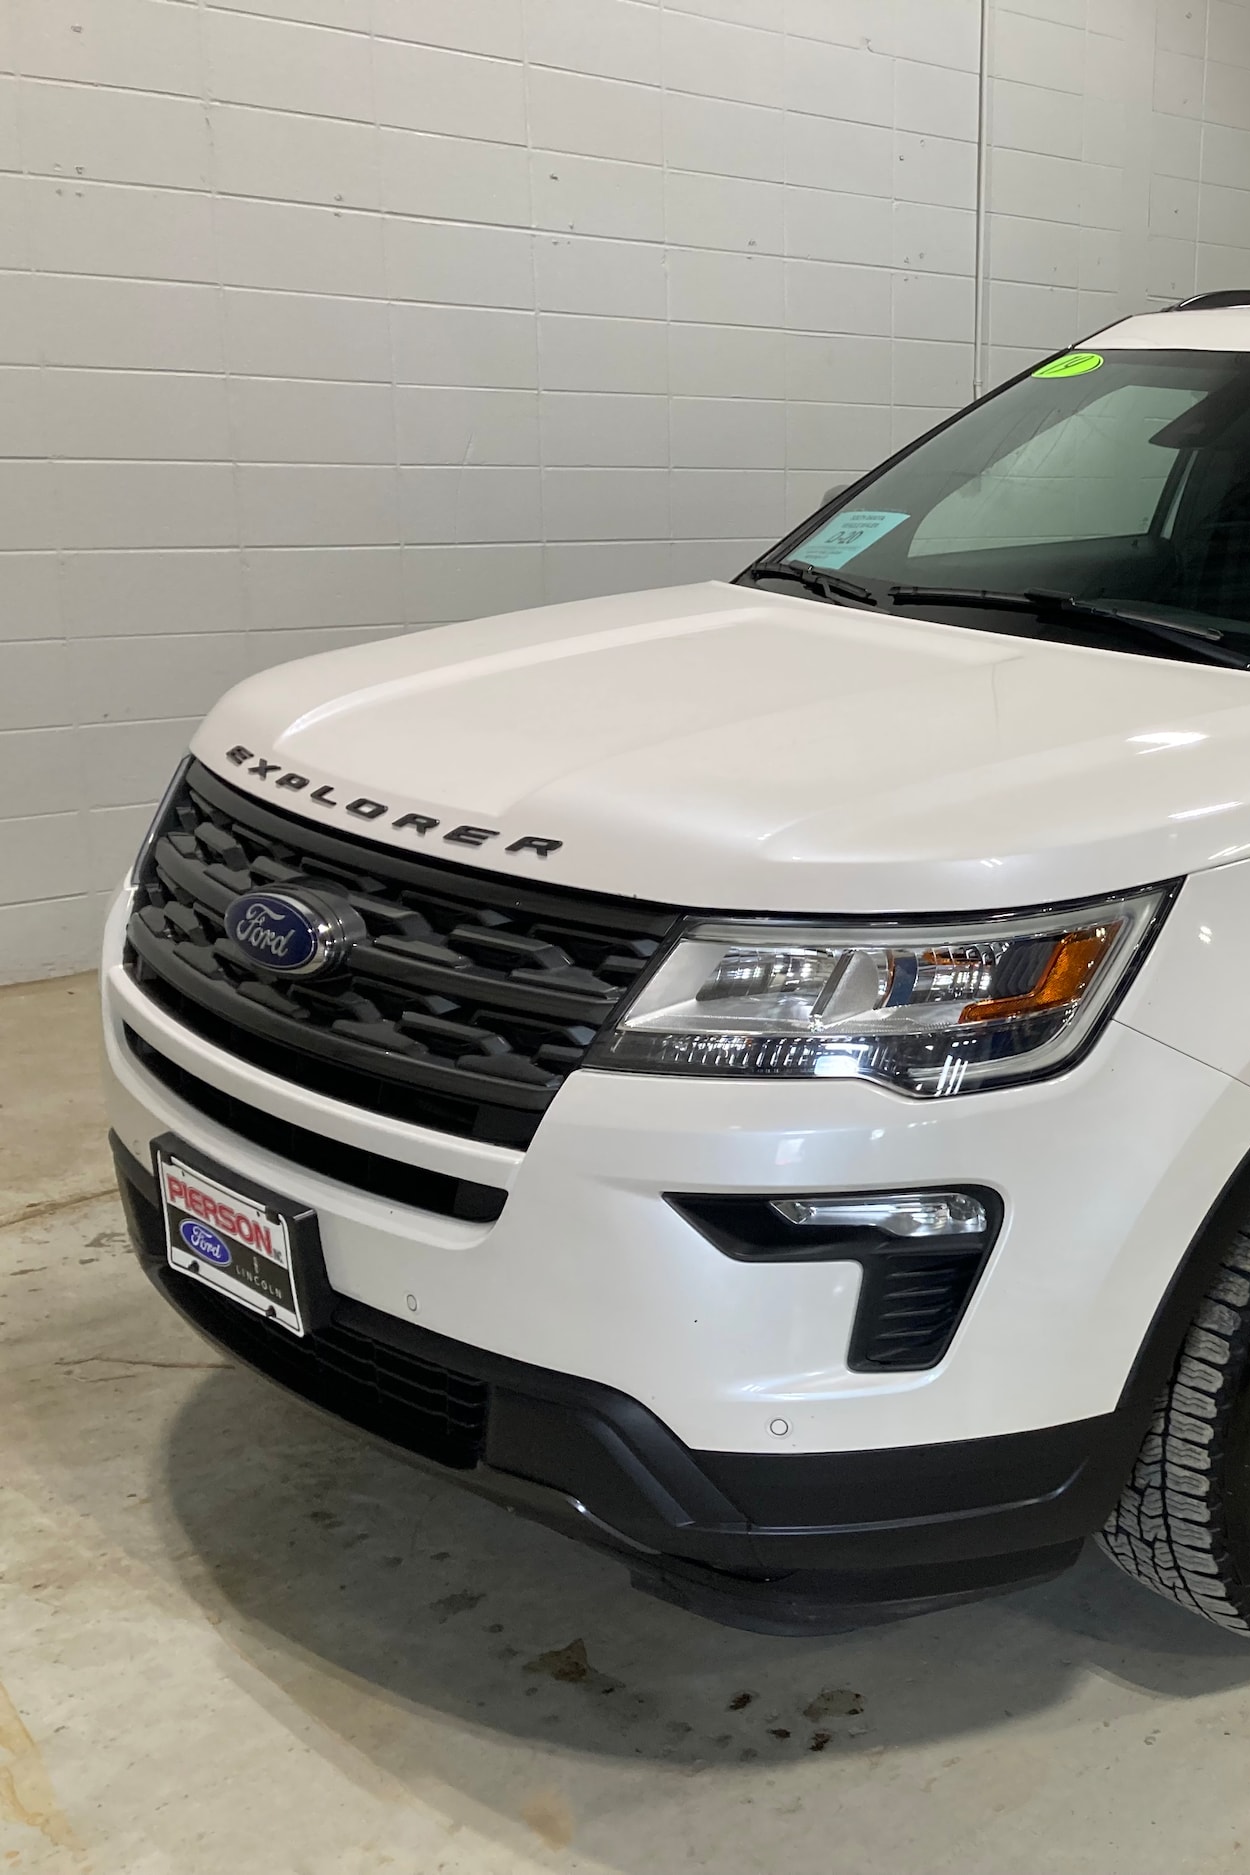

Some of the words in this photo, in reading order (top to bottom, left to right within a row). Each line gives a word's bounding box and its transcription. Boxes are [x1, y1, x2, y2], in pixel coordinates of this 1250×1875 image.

[225, 745, 564, 858] EXPLORER
[236, 904, 295, 957] Ford
[167, 1174, 272, 1254] PIERSON
[190, 1226, 221, 1259] Ford
[235, 1265, 283, 1300] LINCOLN
